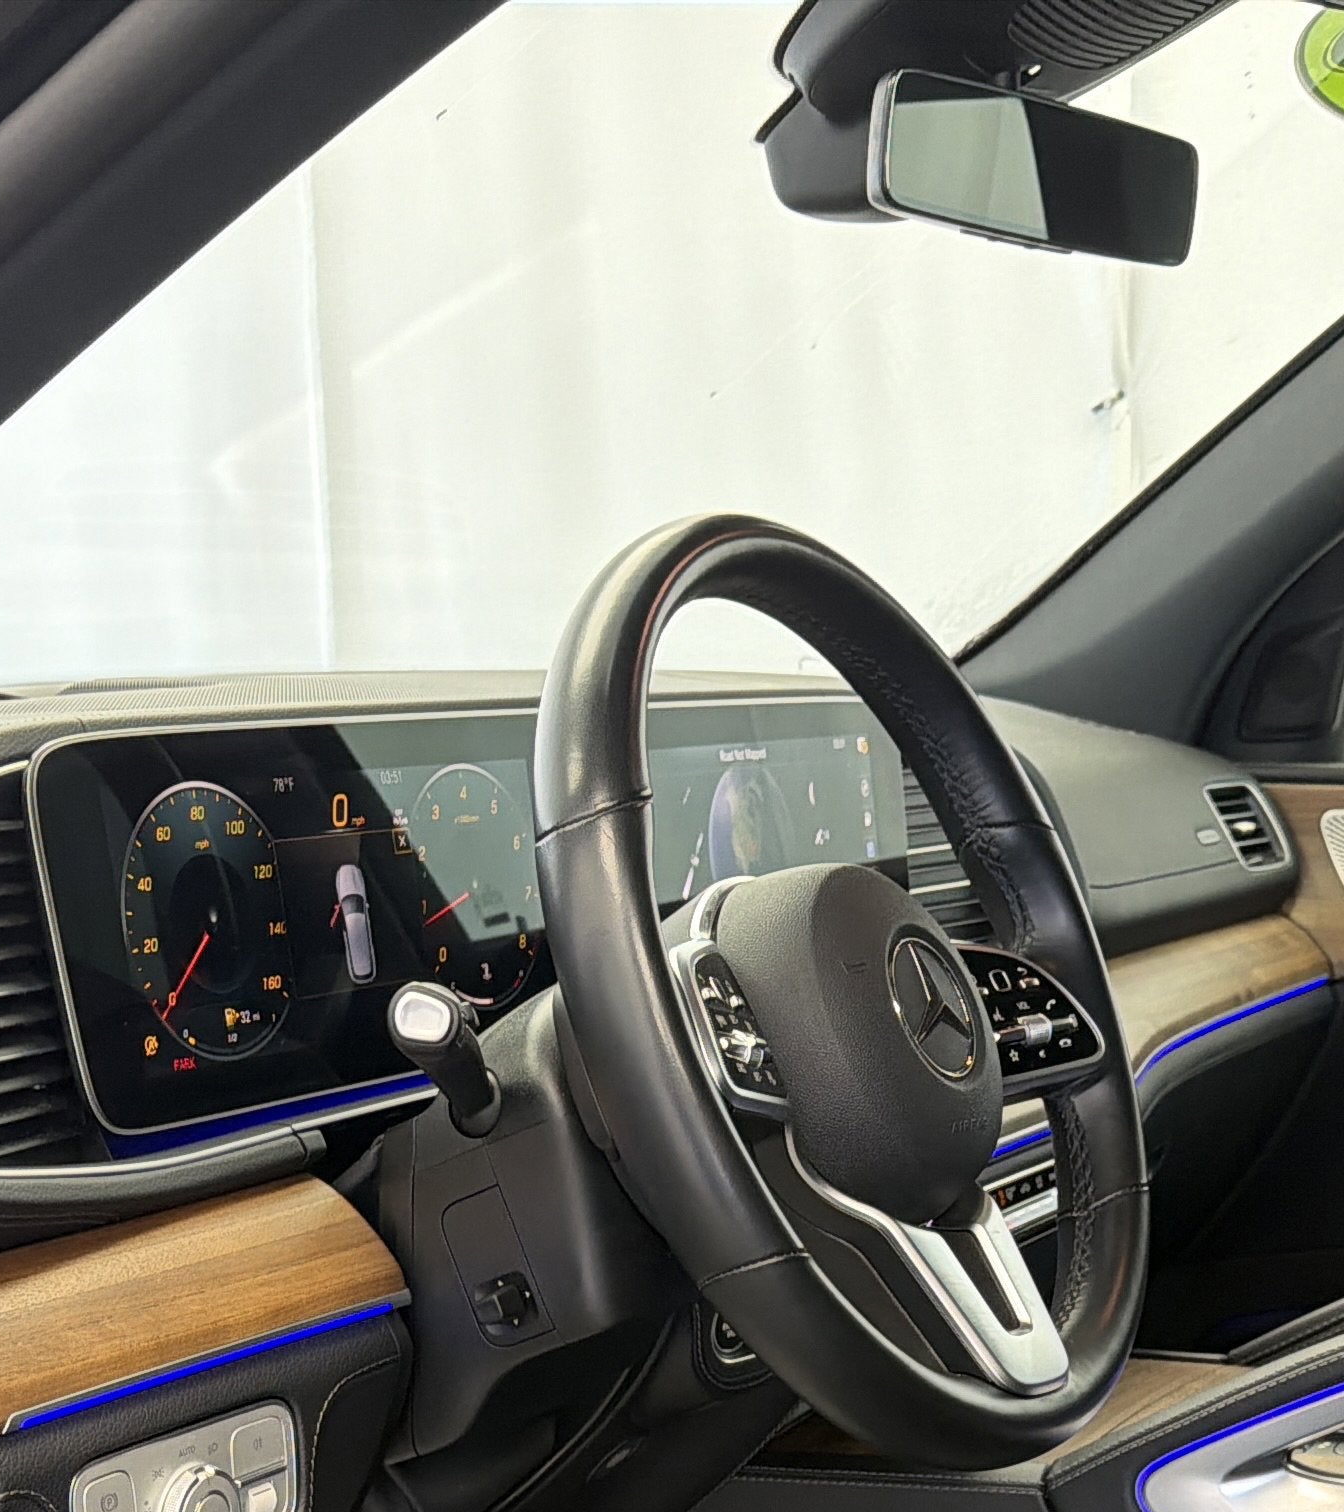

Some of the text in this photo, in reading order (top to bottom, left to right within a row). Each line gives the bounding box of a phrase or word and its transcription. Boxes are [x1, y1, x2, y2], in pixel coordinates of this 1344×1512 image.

[380, 771, 402, 785] 03:51
[460, 786, 467, 800] 4
[190, 806, 205, 821] 80
[332, 793, 348, 828] 0
[432, 805, 440, 820] 3
[490, 801, 498, 816] 5
[157, 826, 171, 841] 60
[226, 821, 245, 835] 100
[194, 840, 210, 851] mph
[513, 836, 521, 850] 6
[418, 846, 426, 861] 2
[254, 864, 273, 880] 120
[137, 877, 152, 892] 40
[269, 921, 287, 936] 140
[144, 938, 158, 953] 20
[519, 933, 527, 949] 8
[439, 946, 447, 962] 0
[263, 975, 281, 990] 160
[240, 1010, 251, 1023] 32
[178, 1445, 196, 1457] AUTO
